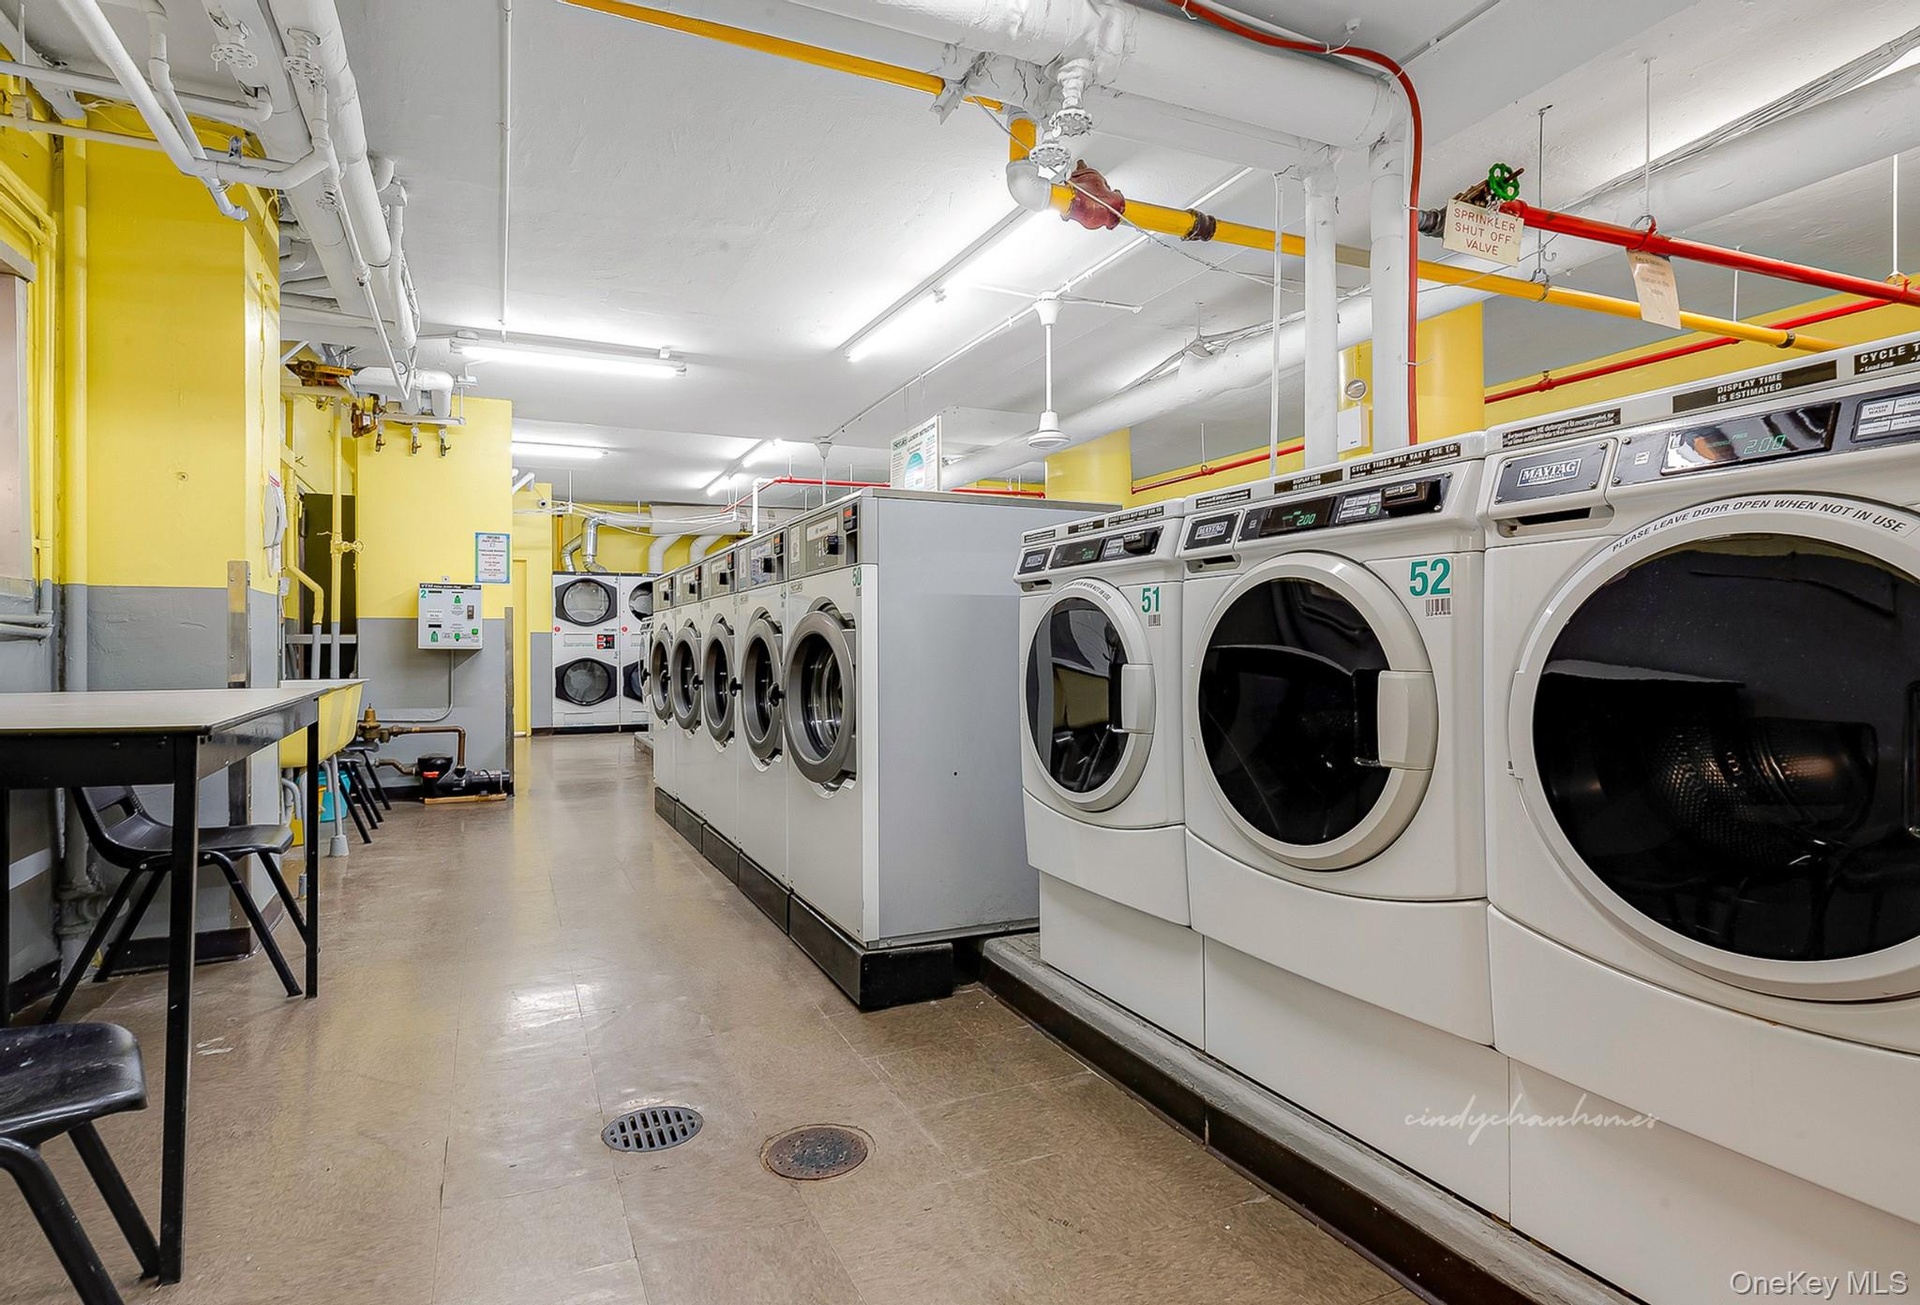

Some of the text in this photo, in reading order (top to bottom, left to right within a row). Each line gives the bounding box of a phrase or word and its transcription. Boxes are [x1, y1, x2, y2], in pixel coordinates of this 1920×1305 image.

[1454, 208, 1516, 233] SPRINKLER
[1454, 222, 1512, 244] SHUT OFF
[1466, 238, 1499, 256] VALVE
[1860, 345, 1906, 364] CYCLE
[1717, 373, 1783, 394] DISPLAY TIME
[1717, 382, 1783, 403] IS ESTIMATED
[1744, 434, 1787, 455] 2.00
[1351, 464, 1371, 473] CYCLE
[1372, 459, 1392, 469] TIMES
[1393, 455, 1408, 464] MAY
[1409, 450, 1427, 461] VARY
[1428, 447, 1442, 455] DUE
[1444, 443, 1458, 453] TO:
[1522, 462, 1577, 480] MAYTAG
[1612, 499, 1907, 552] PLEASE LEAVE DOOR OPEN WHEN NOT IN USE
[852, 566, 861, 587] 50
[1409, 558, 1451, 597] 52
[420, 589, 427, 599] 2
[1141, 586, 1160, 613] 51
